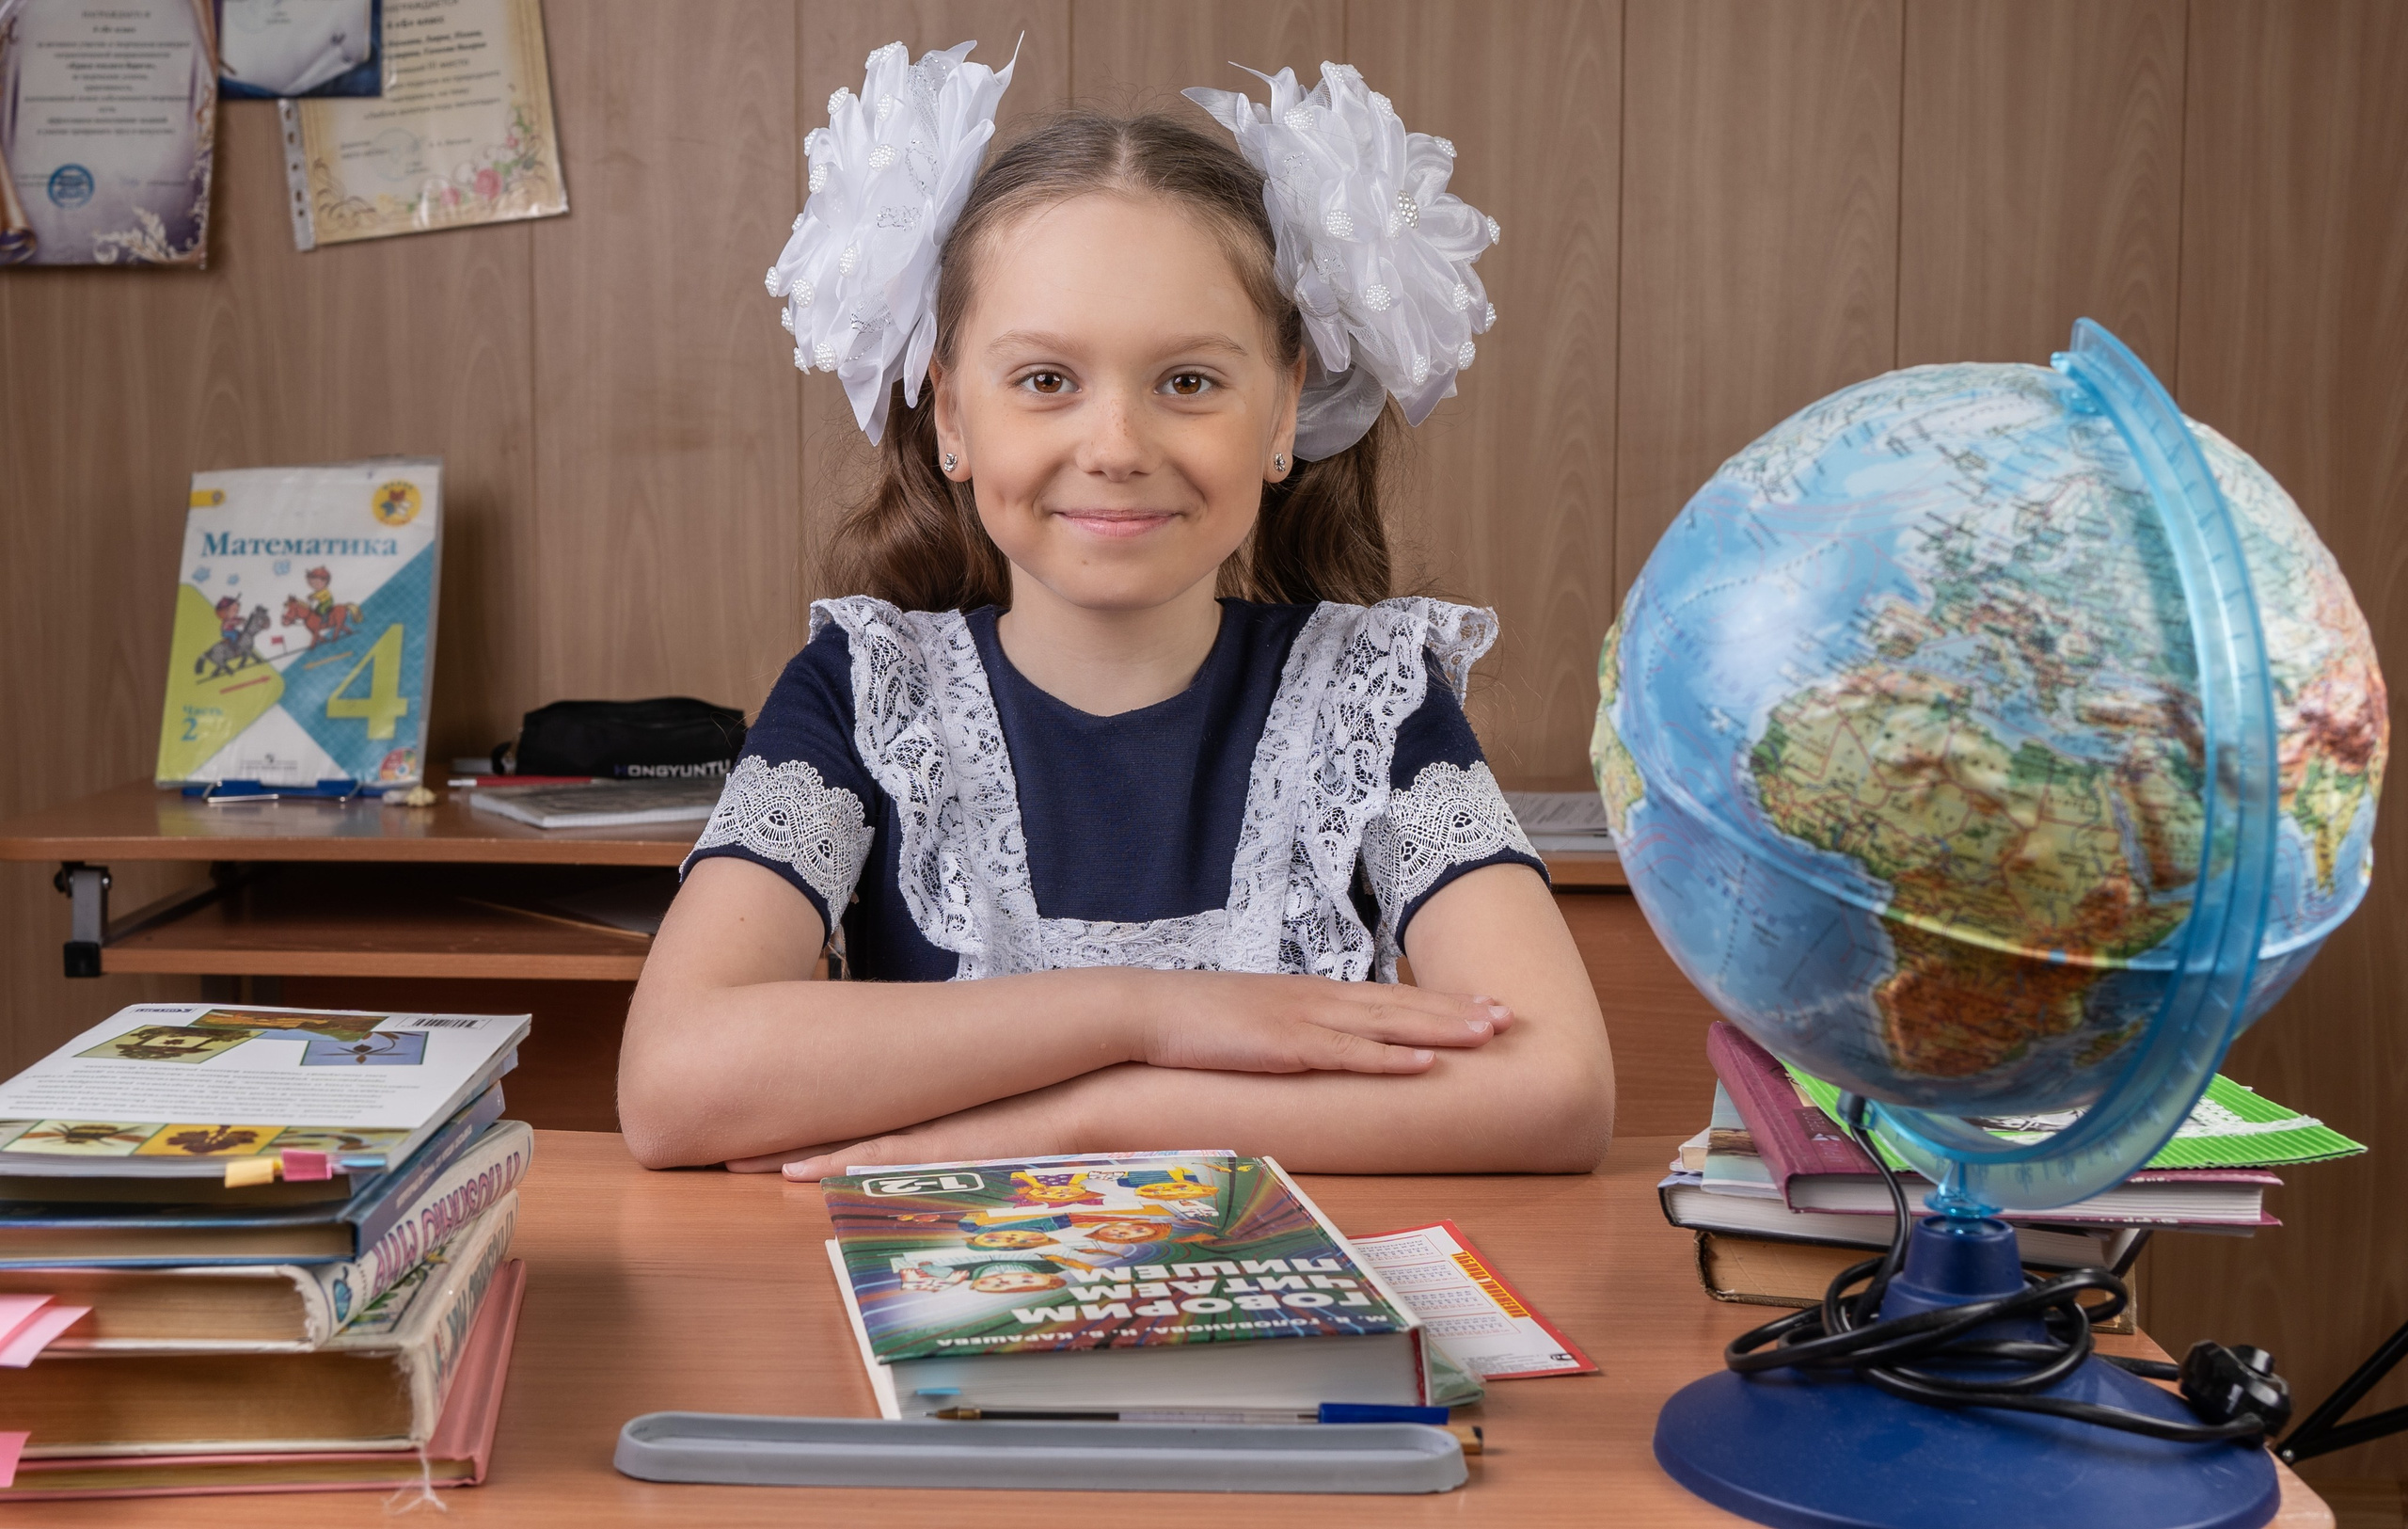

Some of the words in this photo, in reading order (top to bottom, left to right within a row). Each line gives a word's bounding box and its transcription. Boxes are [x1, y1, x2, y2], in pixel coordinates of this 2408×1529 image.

[200, 531, 398, 558] Математика
[326, 623, 408, 741] 4
[181, 717, 198, 741] 2
[613, 758, 731, 778] HONGYUNTU
[878, 1176, 968, 1193] 1-2
[1068, 1258, 1344, 1282] ПИШЕМ
[1450, 1250, 1492, 1281] ТАБЛИЦА
[1068, 1275, 1359, 1301] ЧИТАЕМ
[1010, 1292, 1372, 1324] ГОВОРИМ
[1357, 1314, 1388, 1323] М.
[1145, 1317, 1321, 1335] ГОЛОВАНОВА,
[935, 1331, 1074, 1347] КАРАШЕВА
